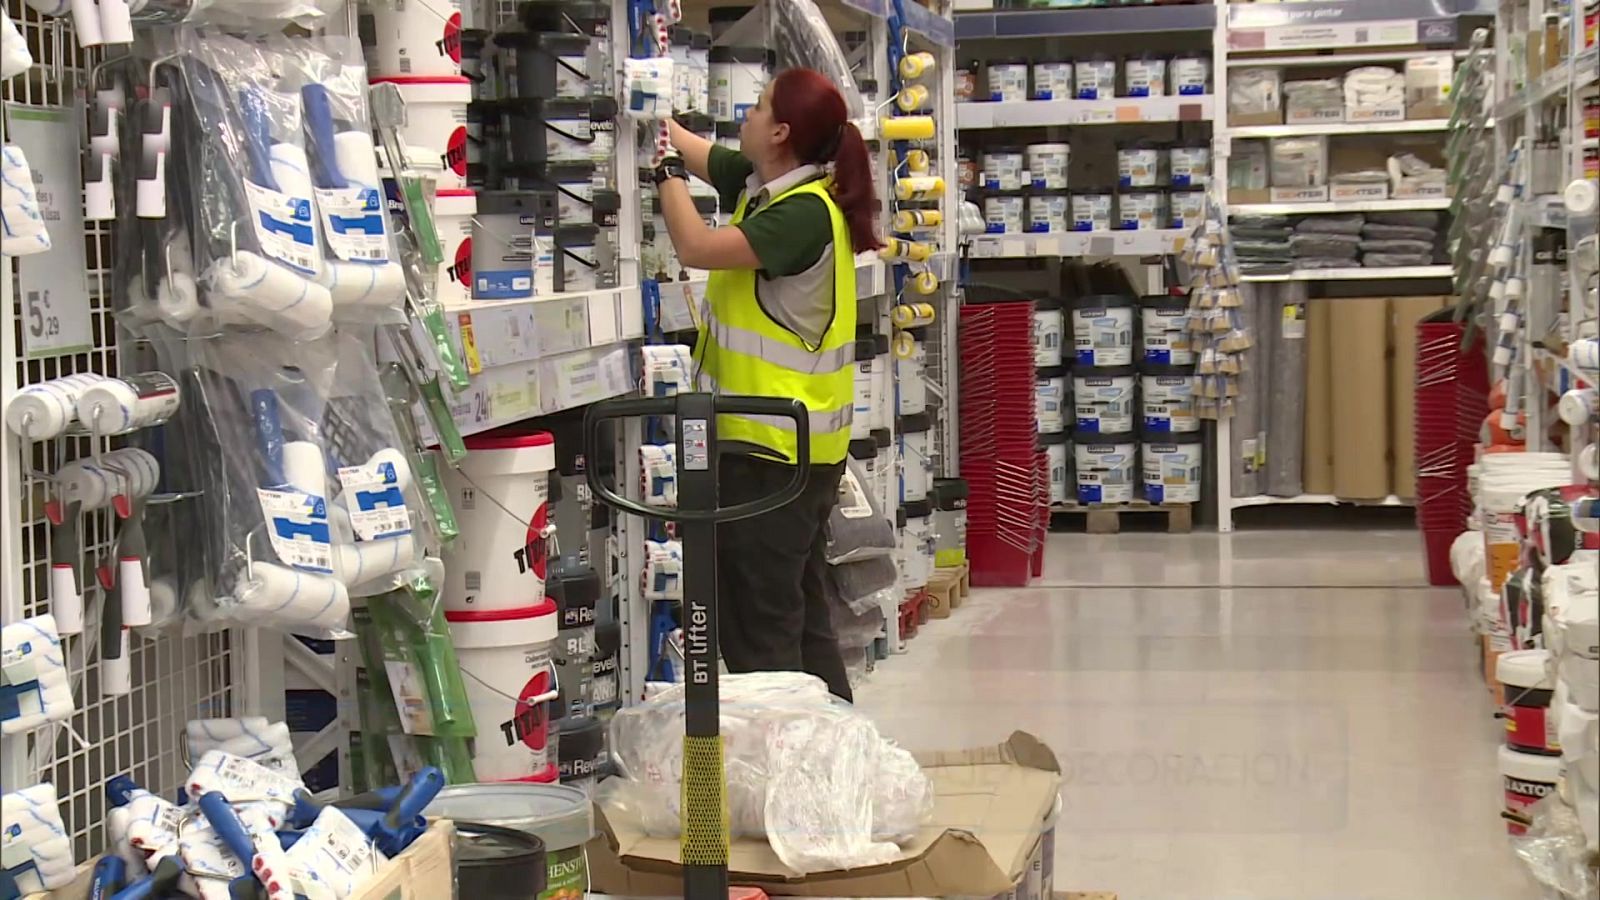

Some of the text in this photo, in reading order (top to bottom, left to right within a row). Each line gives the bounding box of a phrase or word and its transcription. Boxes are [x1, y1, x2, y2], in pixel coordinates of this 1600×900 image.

[1313, 8, 1344, 20] pintar
[28, 291, 43, 338] 5
[688, 601, 708, 684] BT lifter
